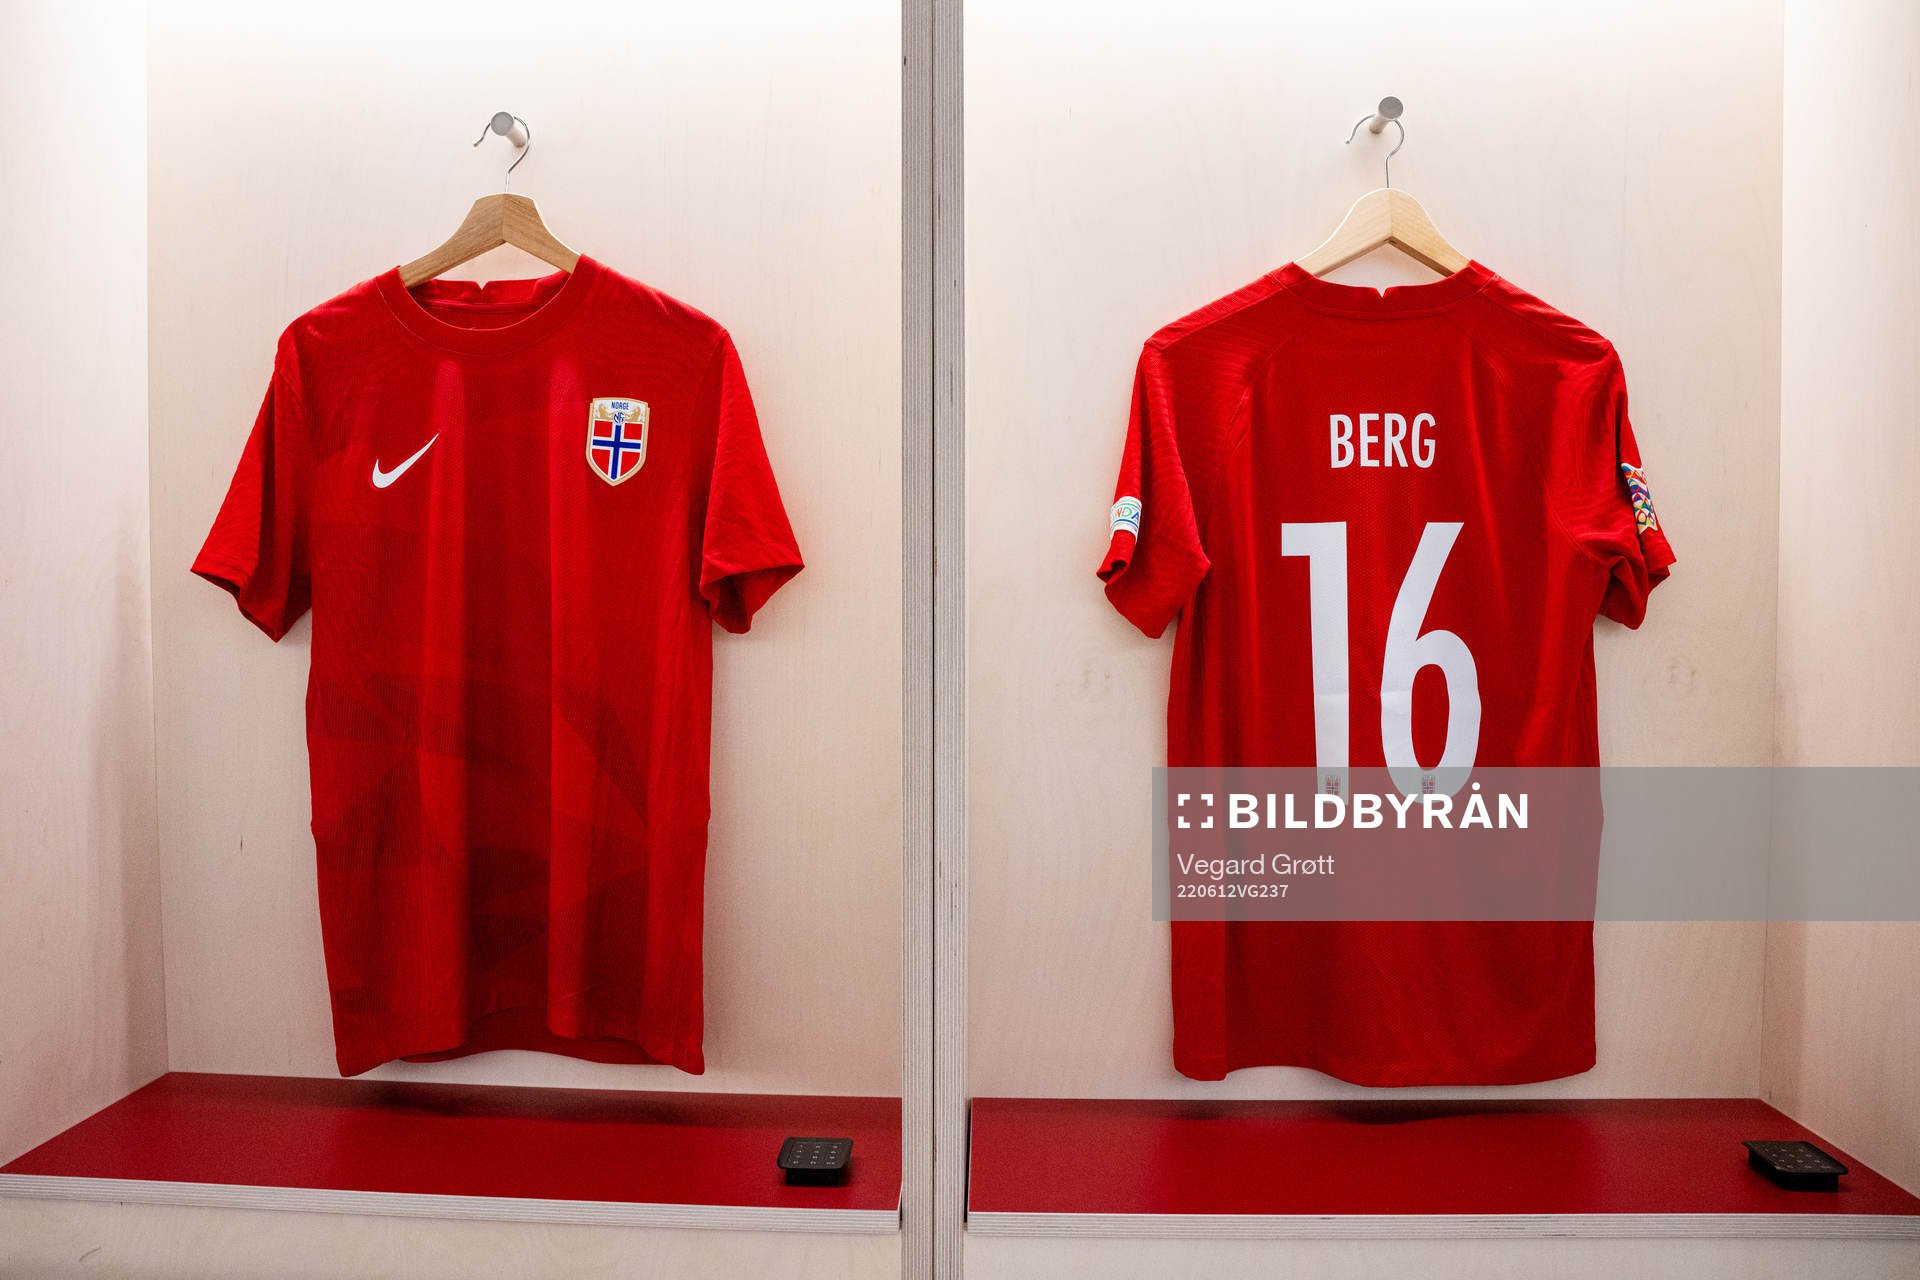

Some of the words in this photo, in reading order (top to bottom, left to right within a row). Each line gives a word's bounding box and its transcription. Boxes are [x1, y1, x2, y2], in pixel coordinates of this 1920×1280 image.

[611, 401, 629, 411] NORGE
[1329, 412, 1437, 469] BERG
[1281, 521, 1482, 806] 16
